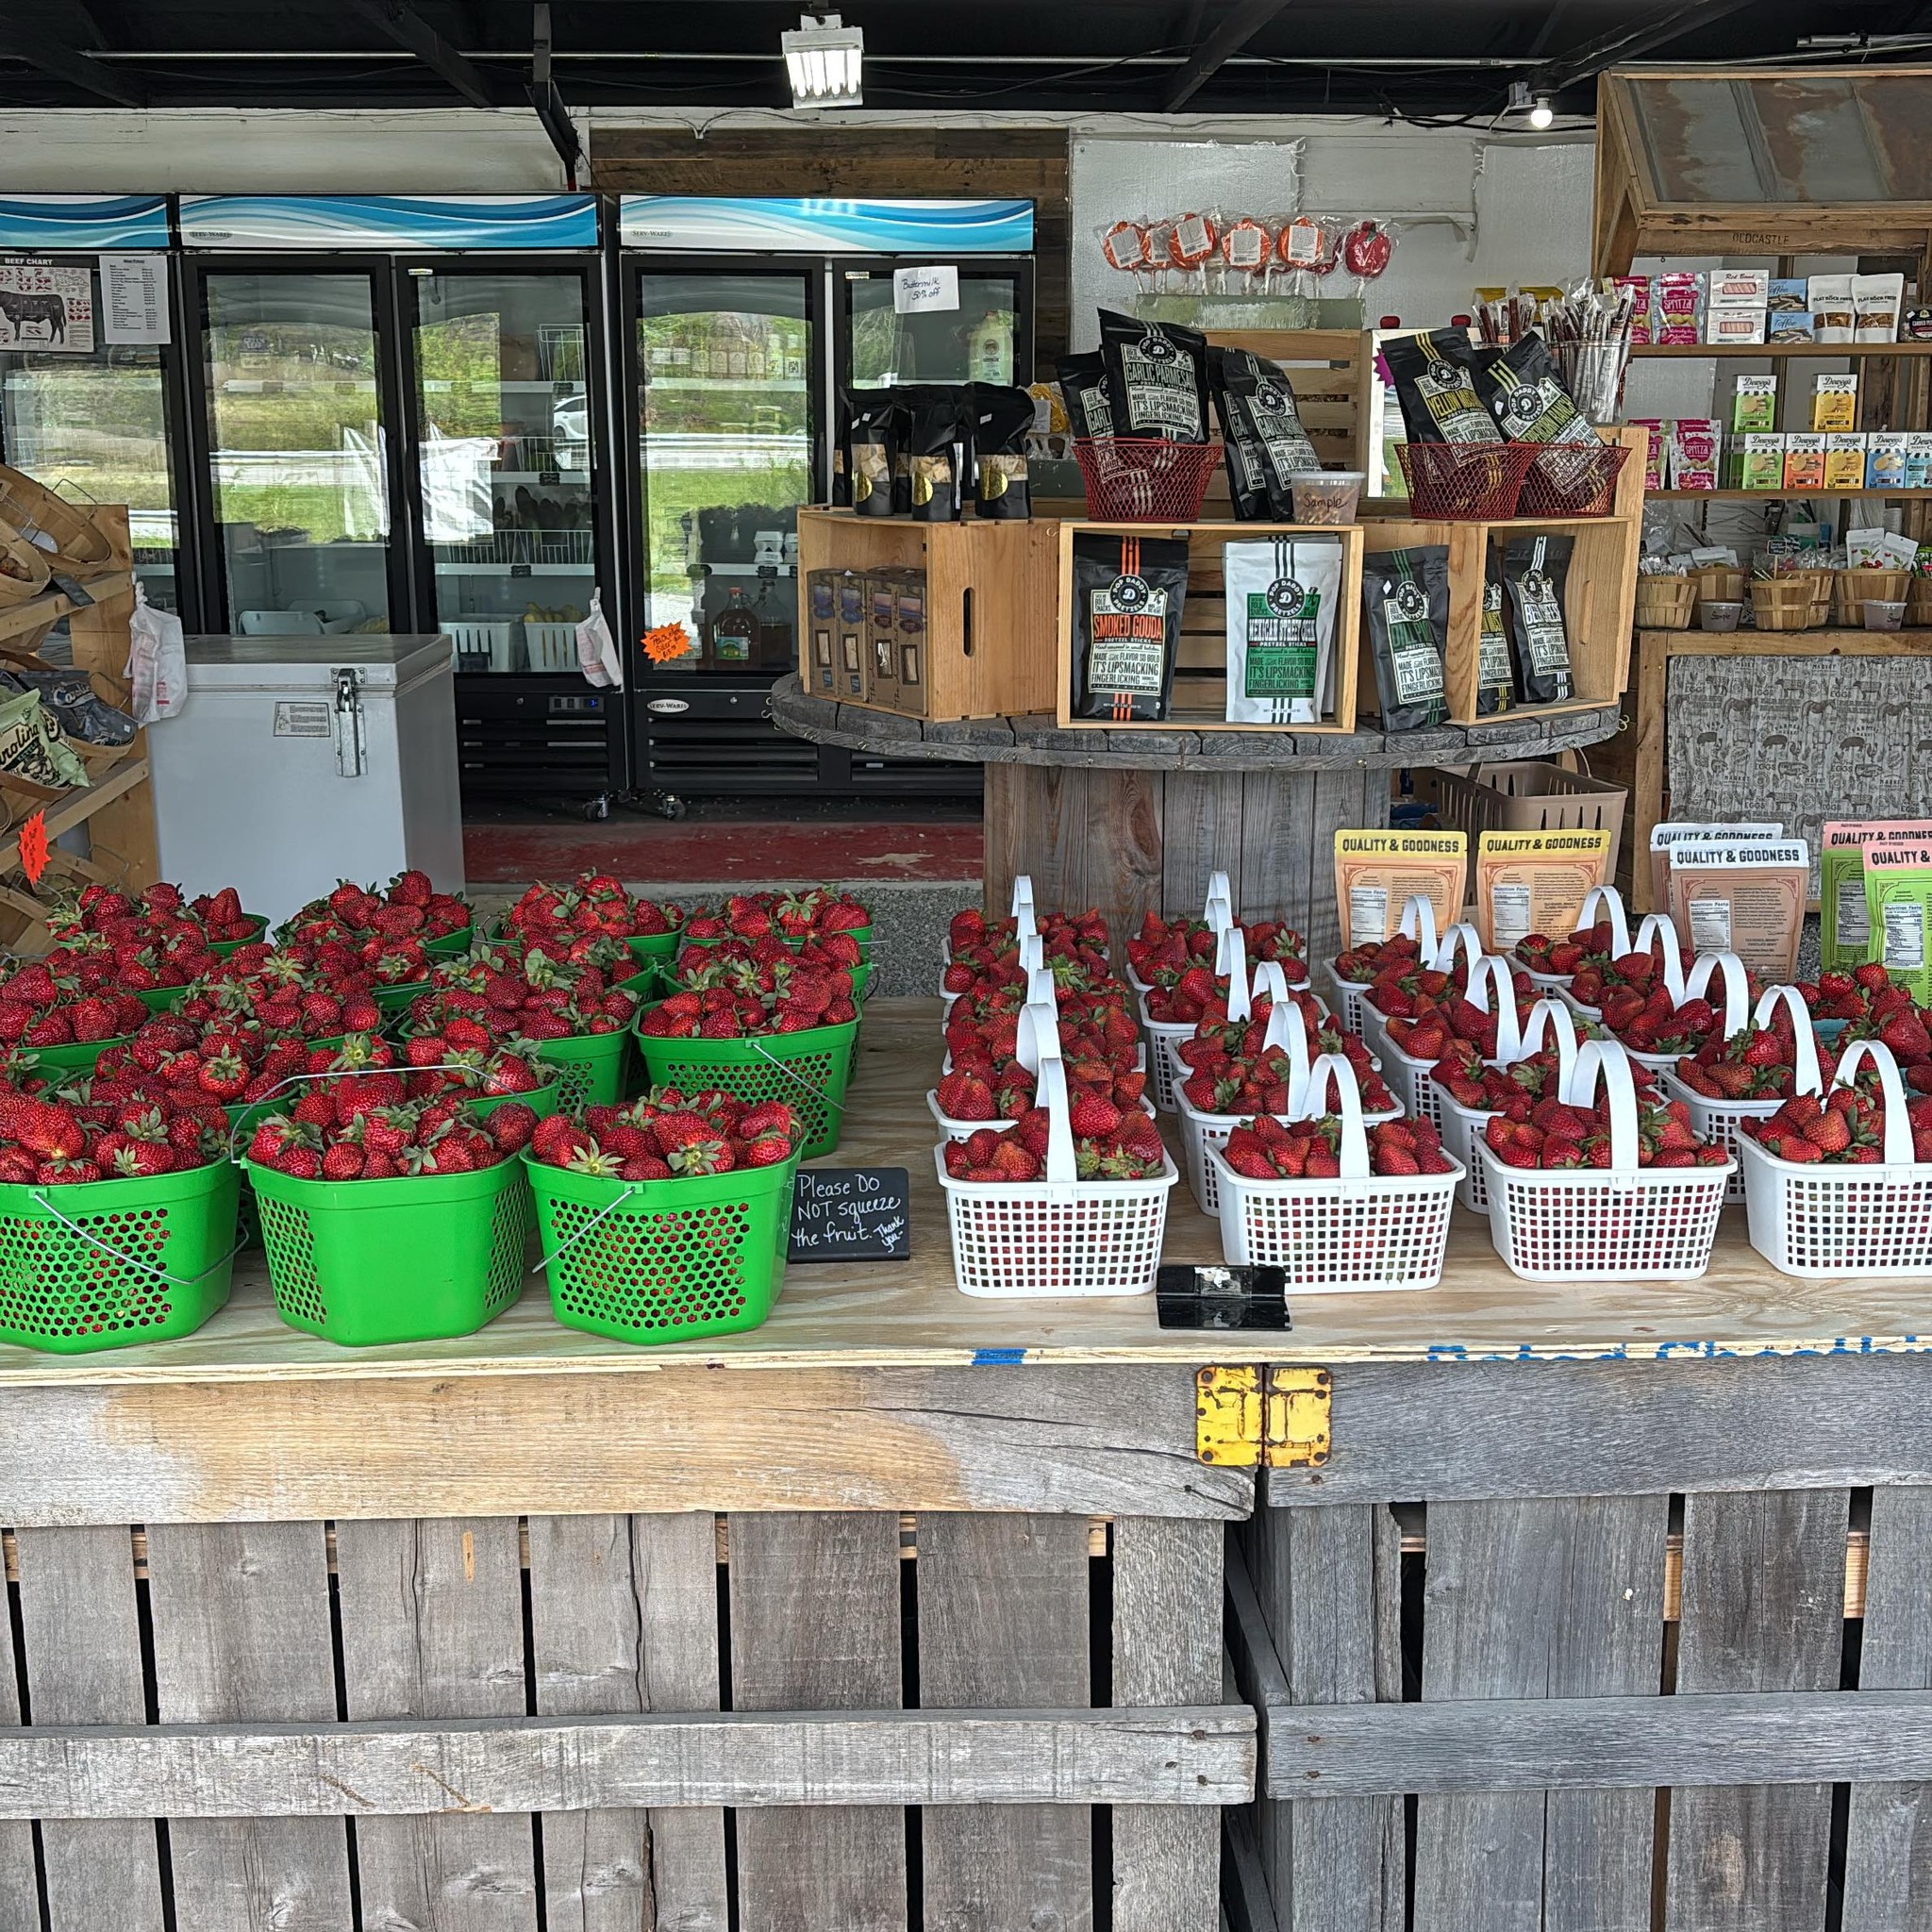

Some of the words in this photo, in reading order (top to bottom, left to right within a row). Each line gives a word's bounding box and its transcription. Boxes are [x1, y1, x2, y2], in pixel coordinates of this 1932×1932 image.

[1732, 232, 1790, 245] OLDCASTLE
[928, 287, 941, 298] off
[1153, 338, 1174, 351] DADDY
[1126, 363, 1156, 382] GARLIC
[1514, 388, 1536, 397] DADDY
[1133, 400, 1148, 410] IT'S
[1150, 401, 1197, 420] LIPSMACKING
[1427, 391, 1463, 419] YELLOW
[1547, 394, 1577, 425] RANCH
[1134, 411, 1183, 422] FINGERLICKING
[1304, 492, 1348, 513] Sample
[1112, 579, 1124, 593] POP
[1125, 576, 1147, 593] DADDY
[1269, 581, 1279, 596] POP
[1281, 580, 1303, 595] DADDY
[1113, 599, 1144, 612] PRETZELS
[1271, 603, 1301, 617] PRETZELS
[1094, 615, 1131, 638] SMOKED
[1133, 615, 1162, 639] GOUDA
[1249, 619, 1278, 641] MEXICAN
[1279, 619, 1302, 641] STREET
[1406, 642, 1426, 651] PRETZEL
[1120, 653, 1139, 661] FLAVOR
[1147, 654, 1159, 662] BOLD
[1250, 657, 1264, 665] MADE
[1092, 661, 1107, 674] IT'S
[1108, 661, 1158, 675] LIPSMACKING
[1250, 666, 1264, 678] IT'S
[1265, 666, 1315, 678] LIPSMACKING
[1398, 661, 1412, 670] MADE
[1091, 674, 1140, 684] FINGERLICKING
[1249, 679, 1299, 688] FINGERLICKING
[1400, 671, 1414, 683] IT'S
[1487, 839, 1532, 853] QUALITY
[1532, 839, 1542, 849] &
[1545, 838, 1602, 849] GOODNESS
[1657, 832, 1700, 845] QUALITY
[1831, 832, 1874, 845] QUALITY
[1342, 839, 1387, 852] QUALITY
[1389, 839, 1399, 851] &
[1402, 840, 1459, 853] GOODNESS
[1677, 851, 1723, 864] QUALITY
[1725, 850, 1736, 862] &
[1739, 849, 1799, 862] GOODNESS
[1872, 852, 1918, 866] QUALITY
[1920, 850, 1930, 862] &
[797, 1174, 851, 1197] Please
[797, 1200, 833, 1221] NOT
[838, 1196, 901, 1224] squeeze
[791, 1227, 820, 1247] the
[823, 1221, 873, 1243] fruit.
[873, 1215, 905, 1239] Thank
